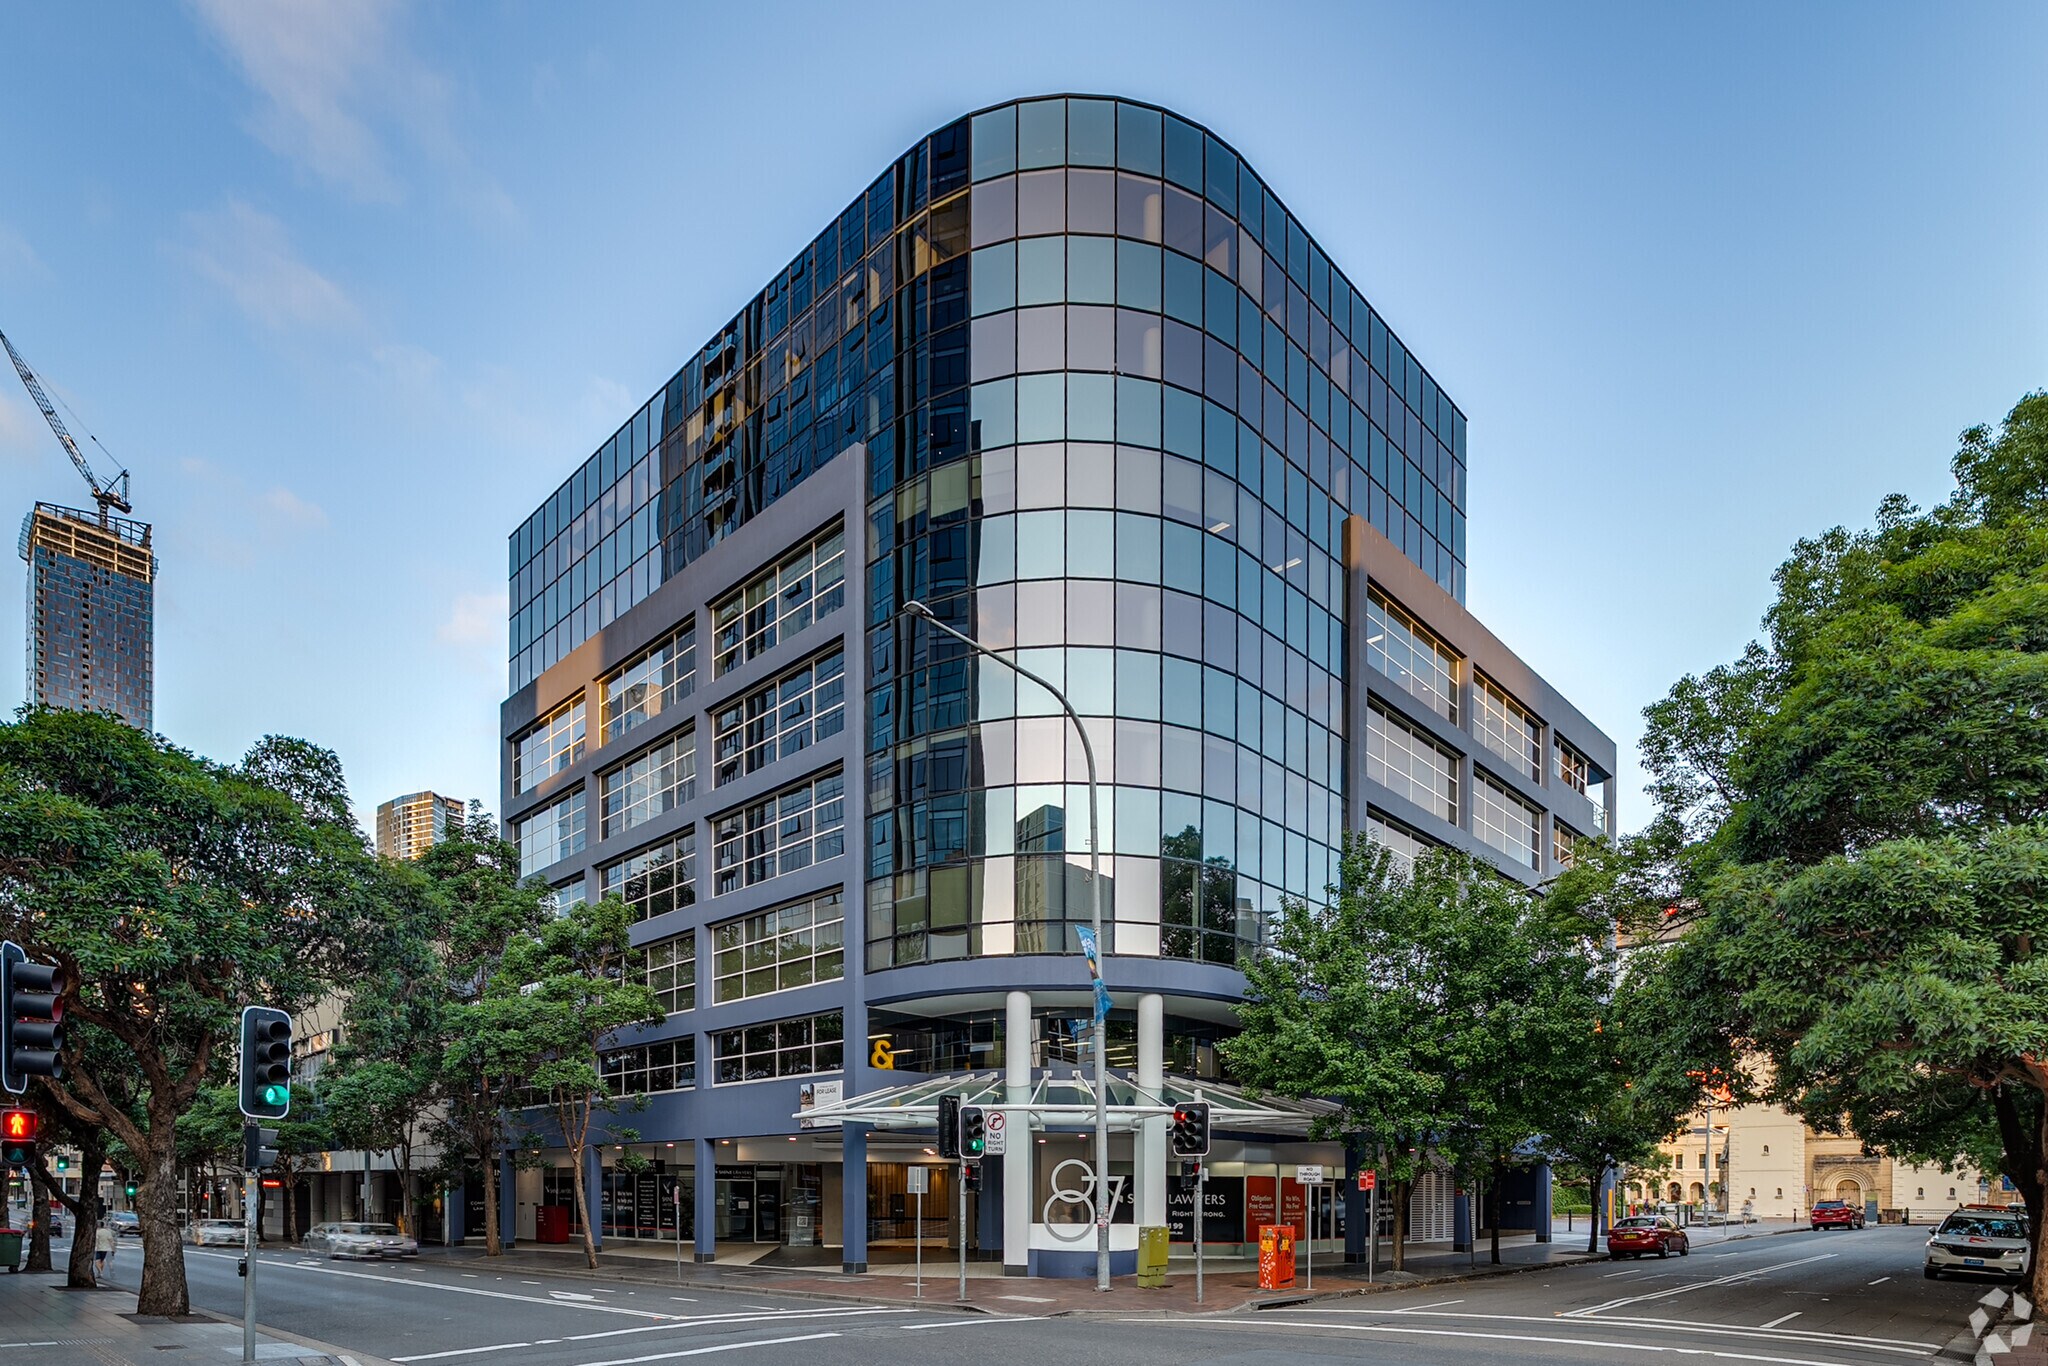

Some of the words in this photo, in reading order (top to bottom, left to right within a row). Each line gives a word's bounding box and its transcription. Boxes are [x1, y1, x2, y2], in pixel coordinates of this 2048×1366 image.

[871, 1039, 894, 1070] &
[990, 1132, 1001, 1140] NO
[1043, 1158, 1126, 1243] 87
[1168, 1193, 1226, 1206] LAWERS
[1172, 1210, 1194, 1218] RIGHT
